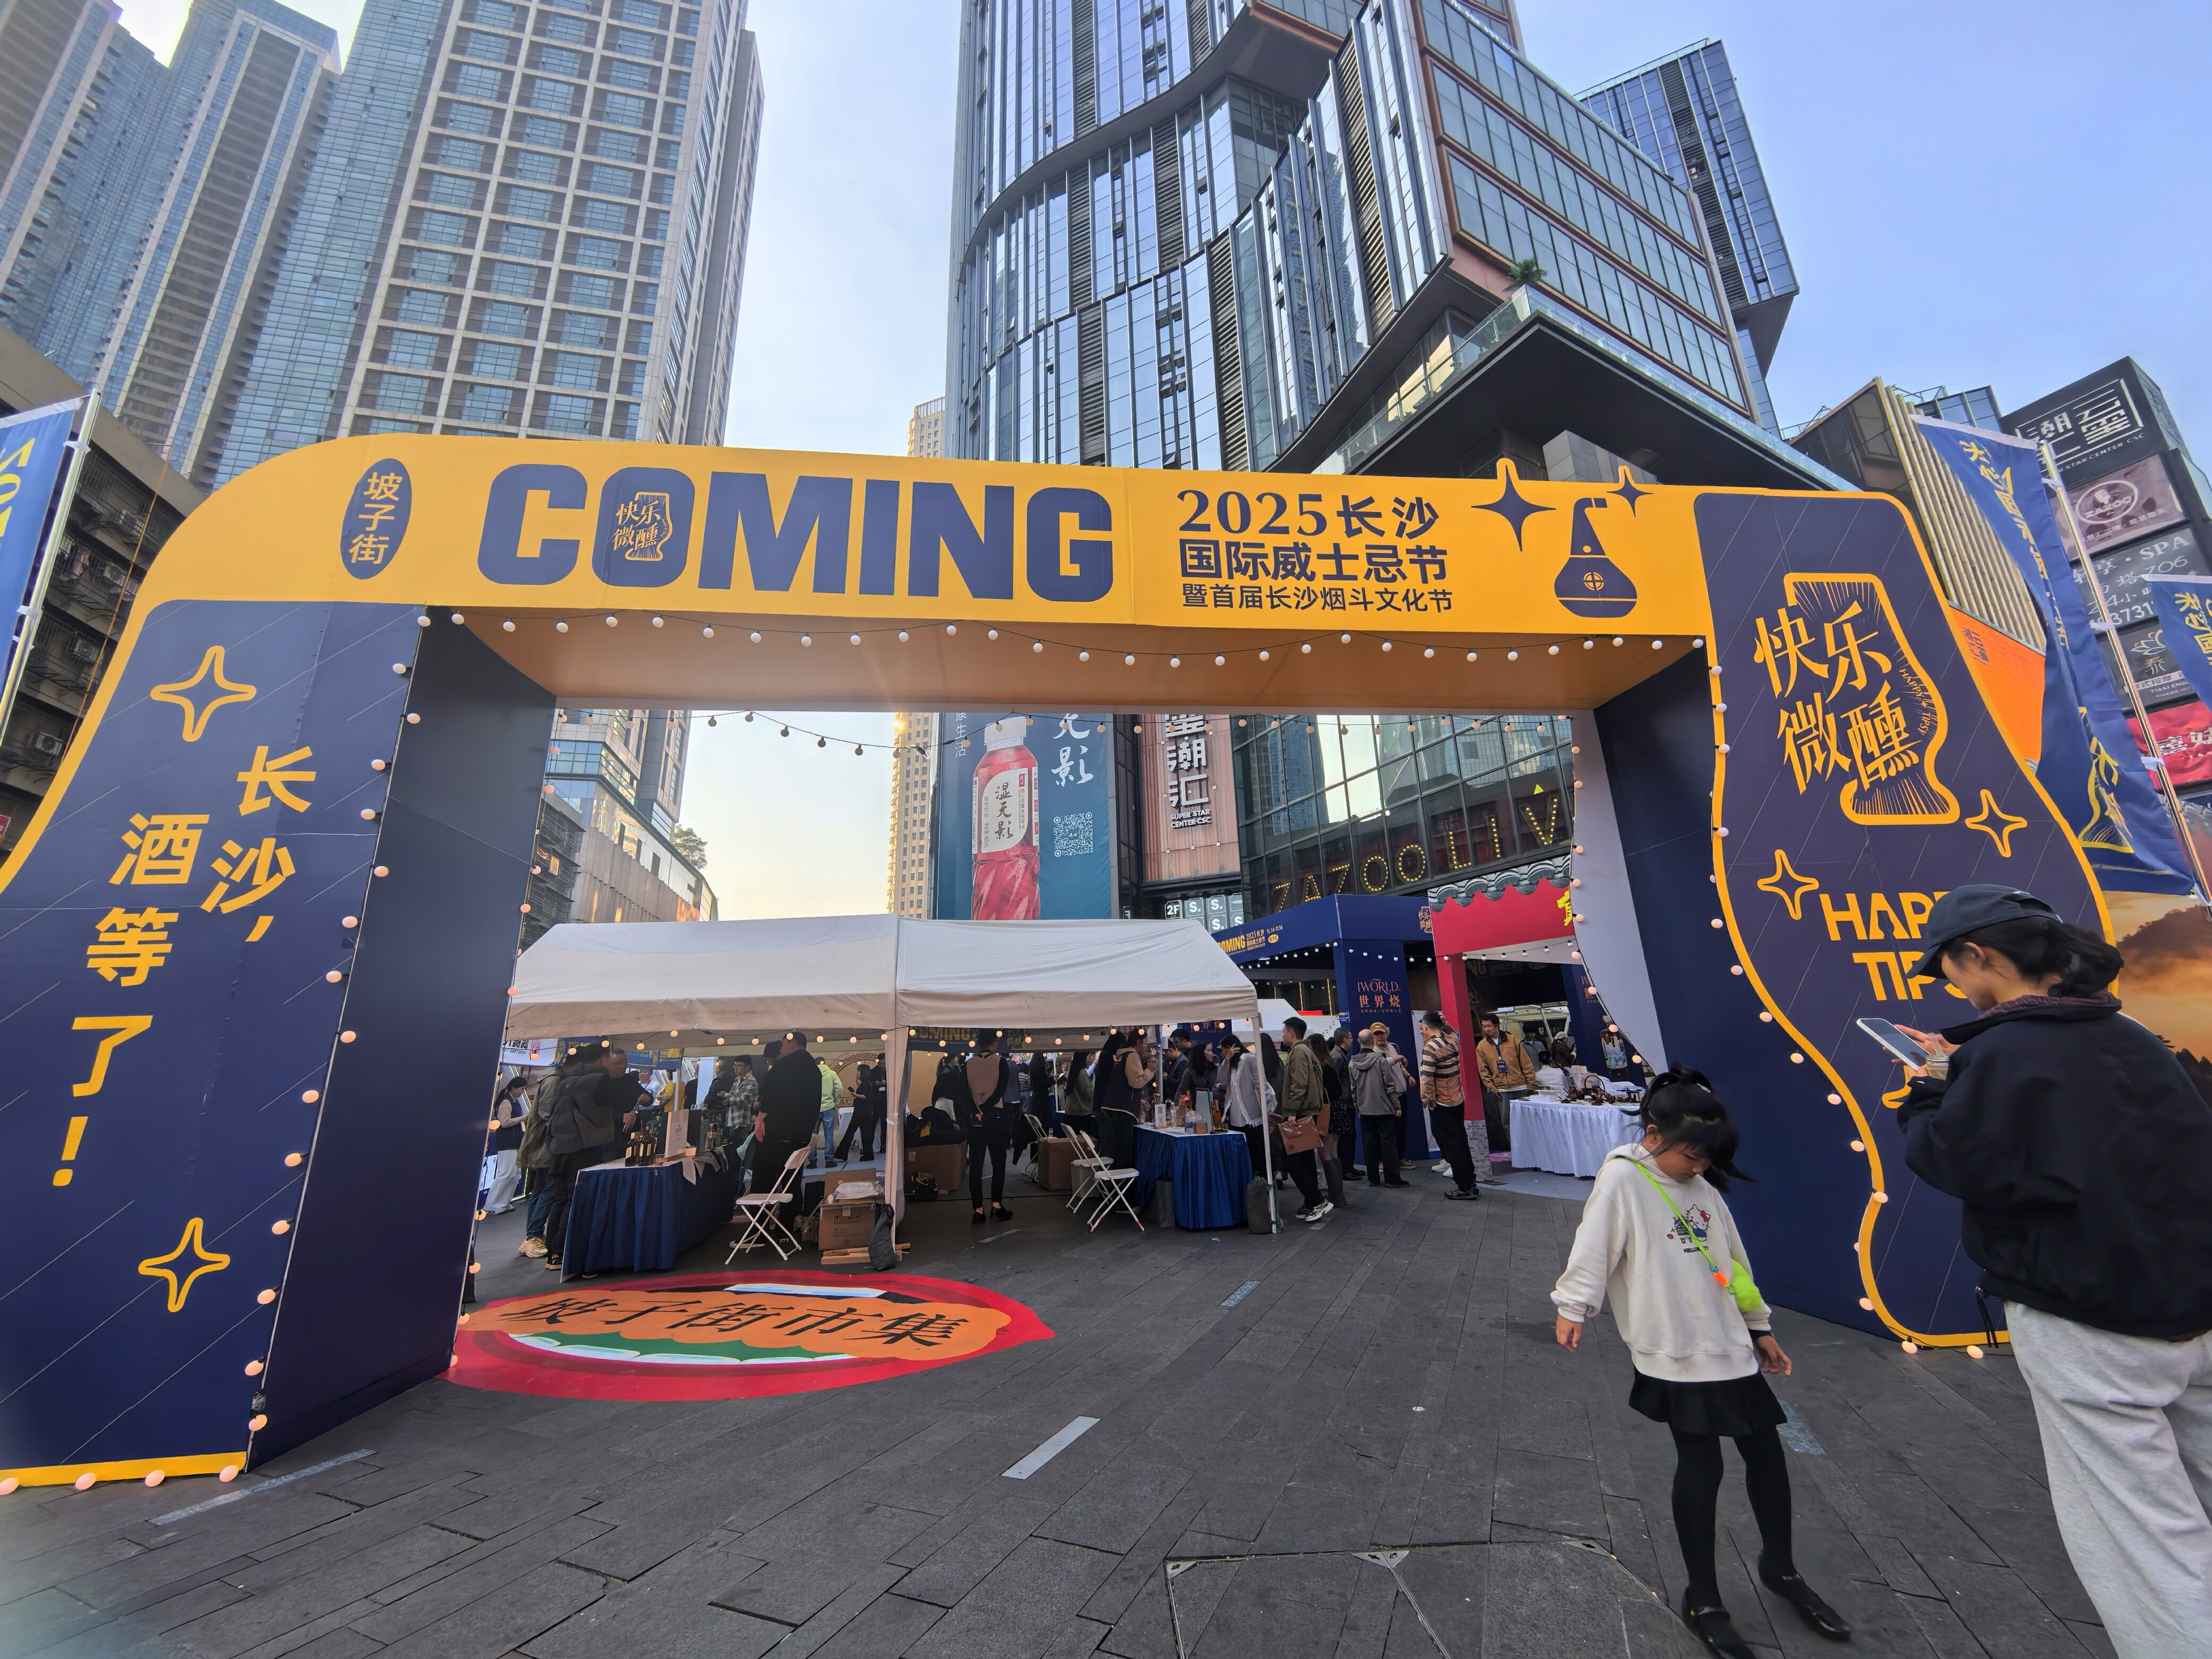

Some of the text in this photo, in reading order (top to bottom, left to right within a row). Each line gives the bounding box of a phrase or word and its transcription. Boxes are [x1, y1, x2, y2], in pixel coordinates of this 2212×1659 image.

[348, 471, 403, 565] 坡子街
[616, 500, 660, 527] 快乐
[1177, 488, 1439, 539] 2025长沙
[2084, 496, 2132, 519] ZAZOO
[477, 463, 1113, 602] COMING
[1179, 538, 1448, 584] 国际威士忌节
[1182, 583, 1453, 613] 暨首届长沙烟斗文化节
[1754, 600, 1892, 703] 快乐
[1898, 668, 1925, 698] HAPPY
[1777, 680, 1922, 795] 微醺
[1917, 712, 1931, 736] TIPSY
[1170, 808, 1210, 820] SUPER STAR
[1167, 905, 1180, 916] 2F
[1819, 892, 1948, 941] HAP
[1359, 995, 1400, 1008] 世界烧
[502, 1297, 970, 1347] 坡子街市集
